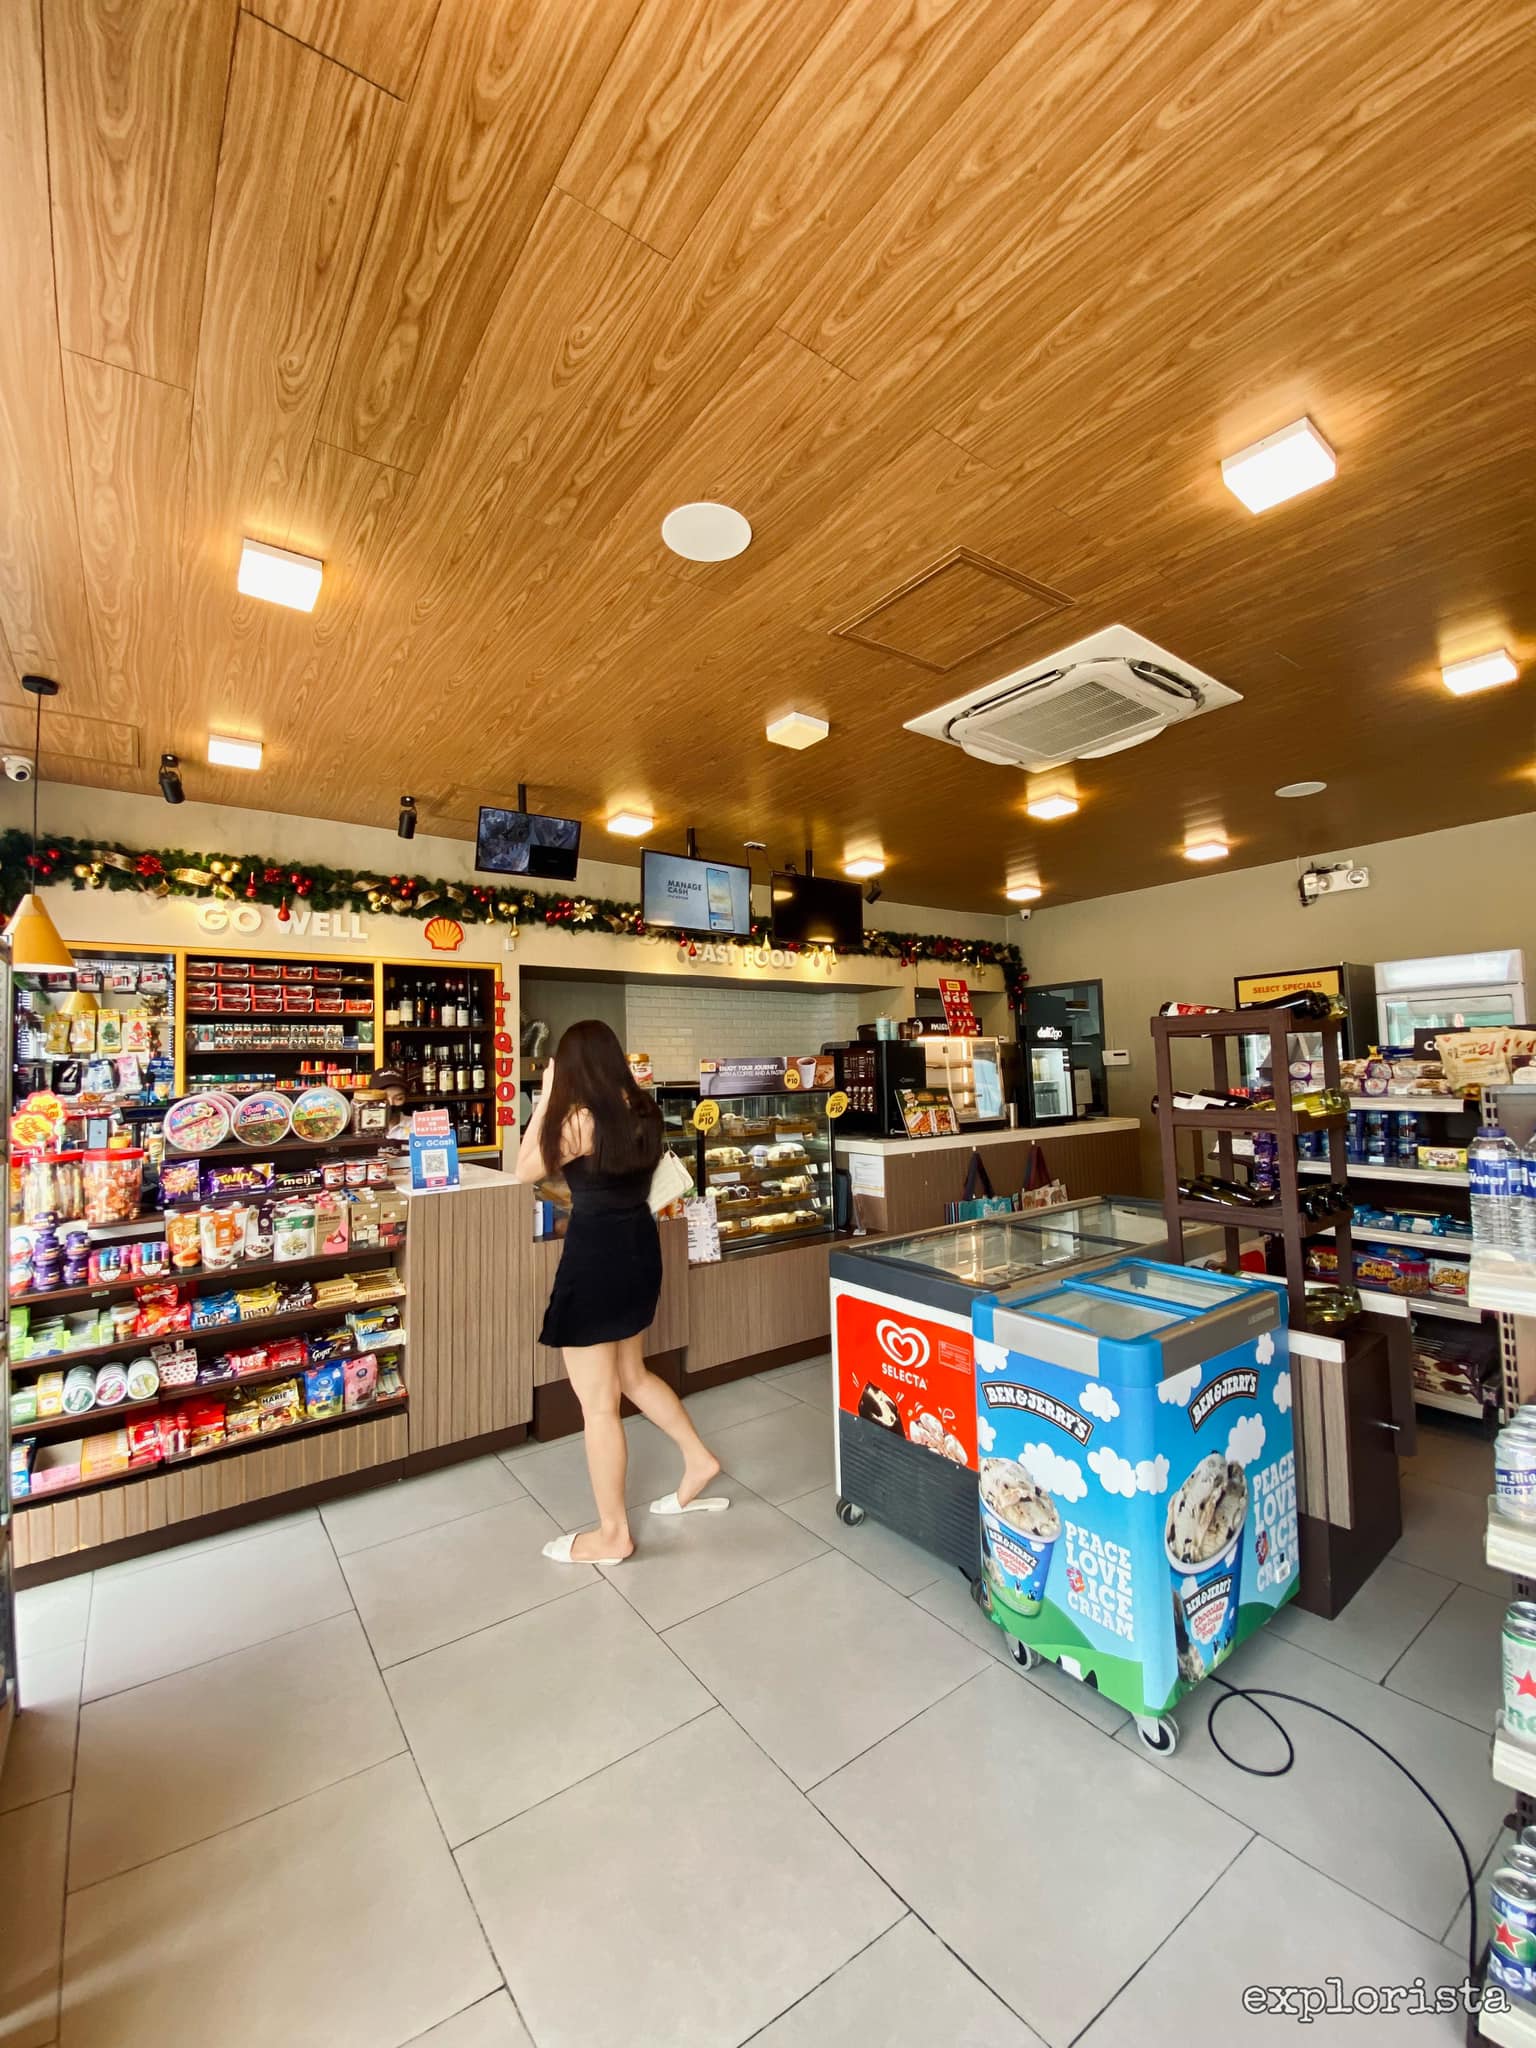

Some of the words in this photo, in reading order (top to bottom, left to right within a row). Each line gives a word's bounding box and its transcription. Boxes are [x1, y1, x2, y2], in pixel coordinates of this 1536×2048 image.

[667, 880, 702, 891] MANAGE
[667, 887, 689, 895] CASH
[199, 902, 262, 932] GO
[275, 909, 369, 939] WELL
[696, 942, 737, 965] FAST
[743, 945, 798, 968] FOOD
[1253, 984, 1279, 995] SELECT
[1282, 980, 1322, 992] SPECIALS
[494, 981, 515, 1126] LIQUOR
[283, 1174, 316, 1187] meiji
[881, 1362, 928, 1391] SELECTA
[1253, 1451, 1296, 1502] PEACE
[1254, 1480, 1298, 1537] LOVE
[1065, 1520, 1132, 1571] PEACE
[1269, 1513, 1298, 1556] ICE
[1065, 1541, 1133, 1597] LOVE
[1257, 1539, 1300, 1593] CREM
[1067, 1591, 1135, 1642] CREAM
[1087, 1578, 1134, 1621] ICE
